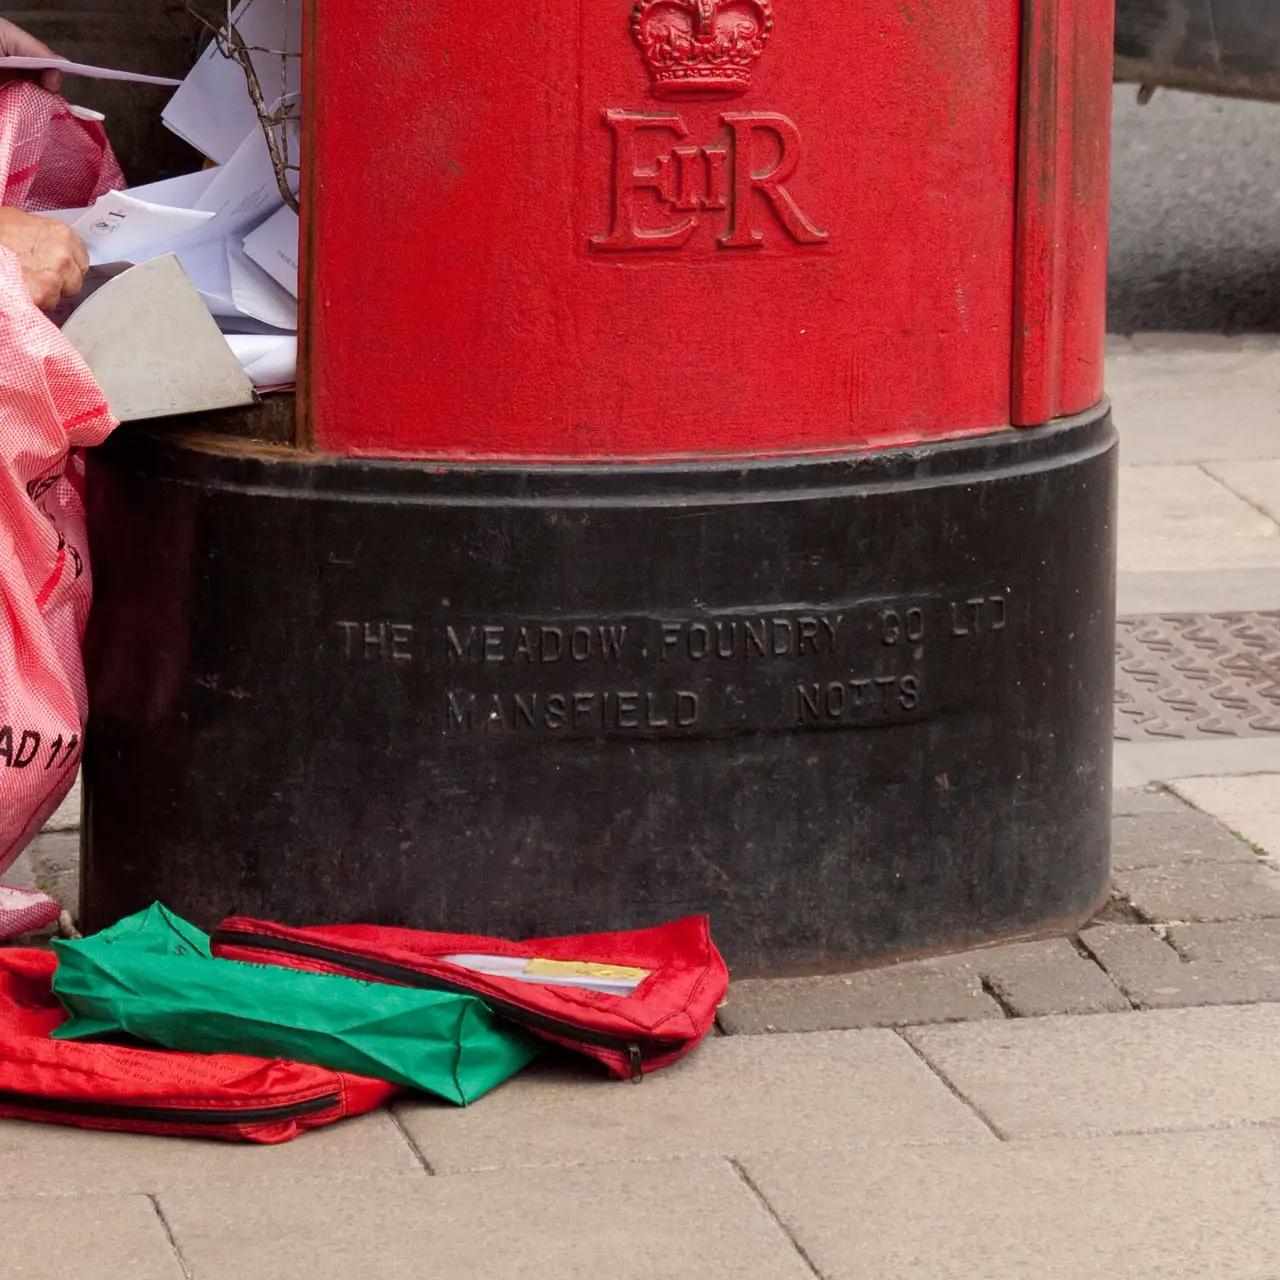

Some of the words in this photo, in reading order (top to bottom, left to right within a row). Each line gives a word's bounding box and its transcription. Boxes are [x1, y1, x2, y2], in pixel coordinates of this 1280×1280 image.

[336, 619, 414, 662] THE
[444, 623, 629, 664] MEADOW
[659, 615, 843, 661] FOUNDRY
[949, 594, 1008, 638] LTD
[443, 690, 701, 733] MANSFIELD
[796, 674, 920, 725] NOTTS
